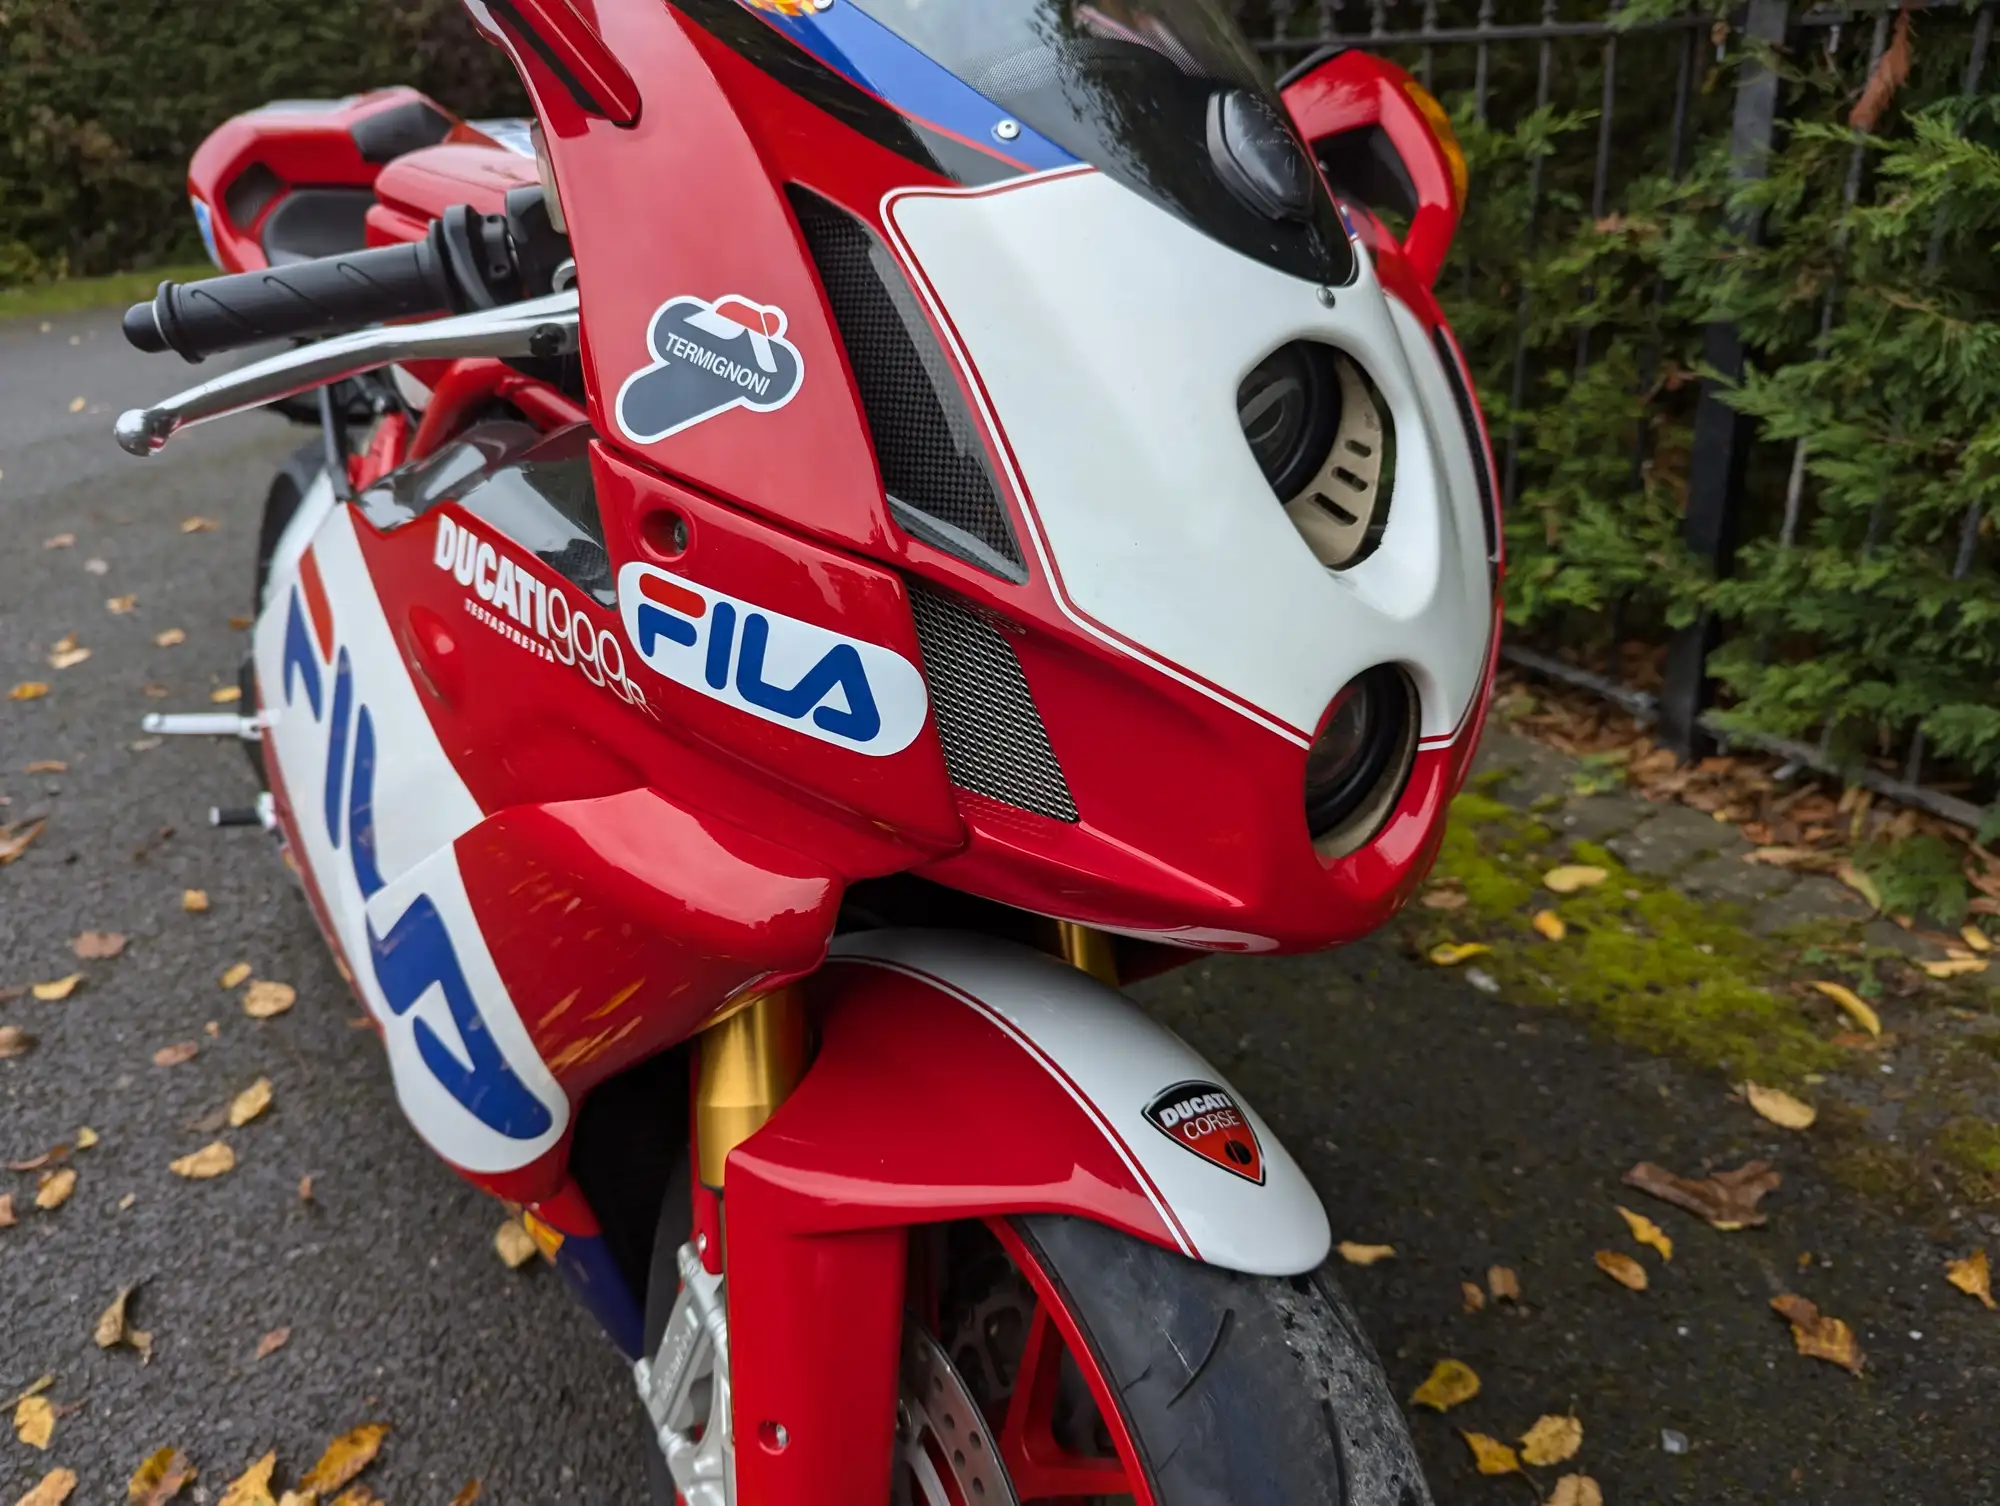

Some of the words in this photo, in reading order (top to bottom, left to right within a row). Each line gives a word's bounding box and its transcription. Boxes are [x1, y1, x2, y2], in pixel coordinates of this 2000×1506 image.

[665, 332, 771, 396] TERMIGNONI
[434, 512, 550, 640] DUCATI
[463, 597, 556, 664] TESTASTRETTA
[638, 572, 881, 742] FILA
[283, 542, 552, 1140] FILA
[1159, 1092, 1234, 1129] DUCATI
[1182, 1109, 1241, 1141] CORSE
